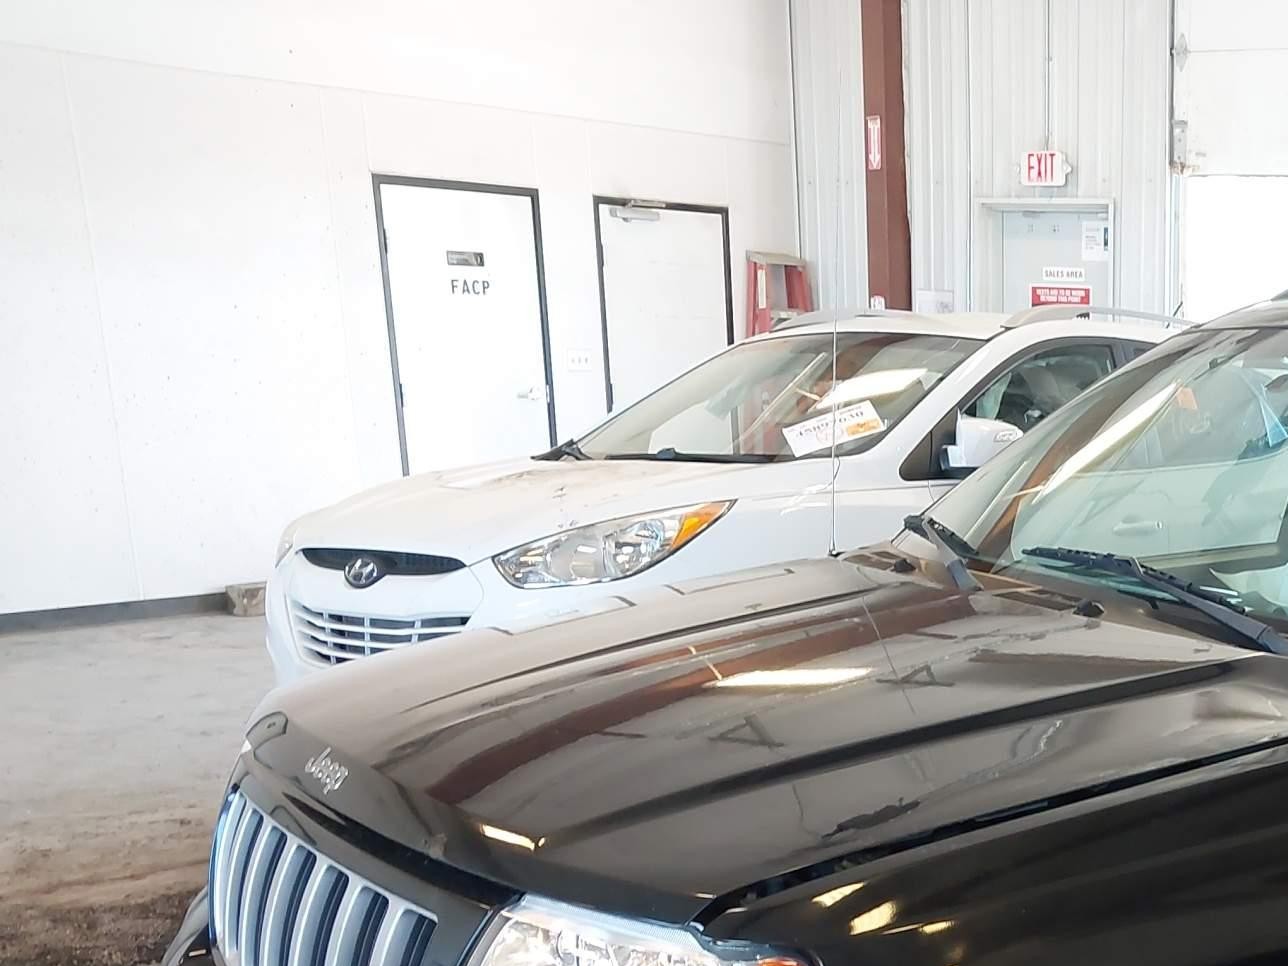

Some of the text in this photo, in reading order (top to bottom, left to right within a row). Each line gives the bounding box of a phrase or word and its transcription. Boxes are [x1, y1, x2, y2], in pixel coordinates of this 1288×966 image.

[1027, 153, 1056, 182] EXIT
[1044, 269, 1083, 279] SALES AREA
[451, 279, 490, 295] FACP
[304, 747, 349, 795] Jeep
